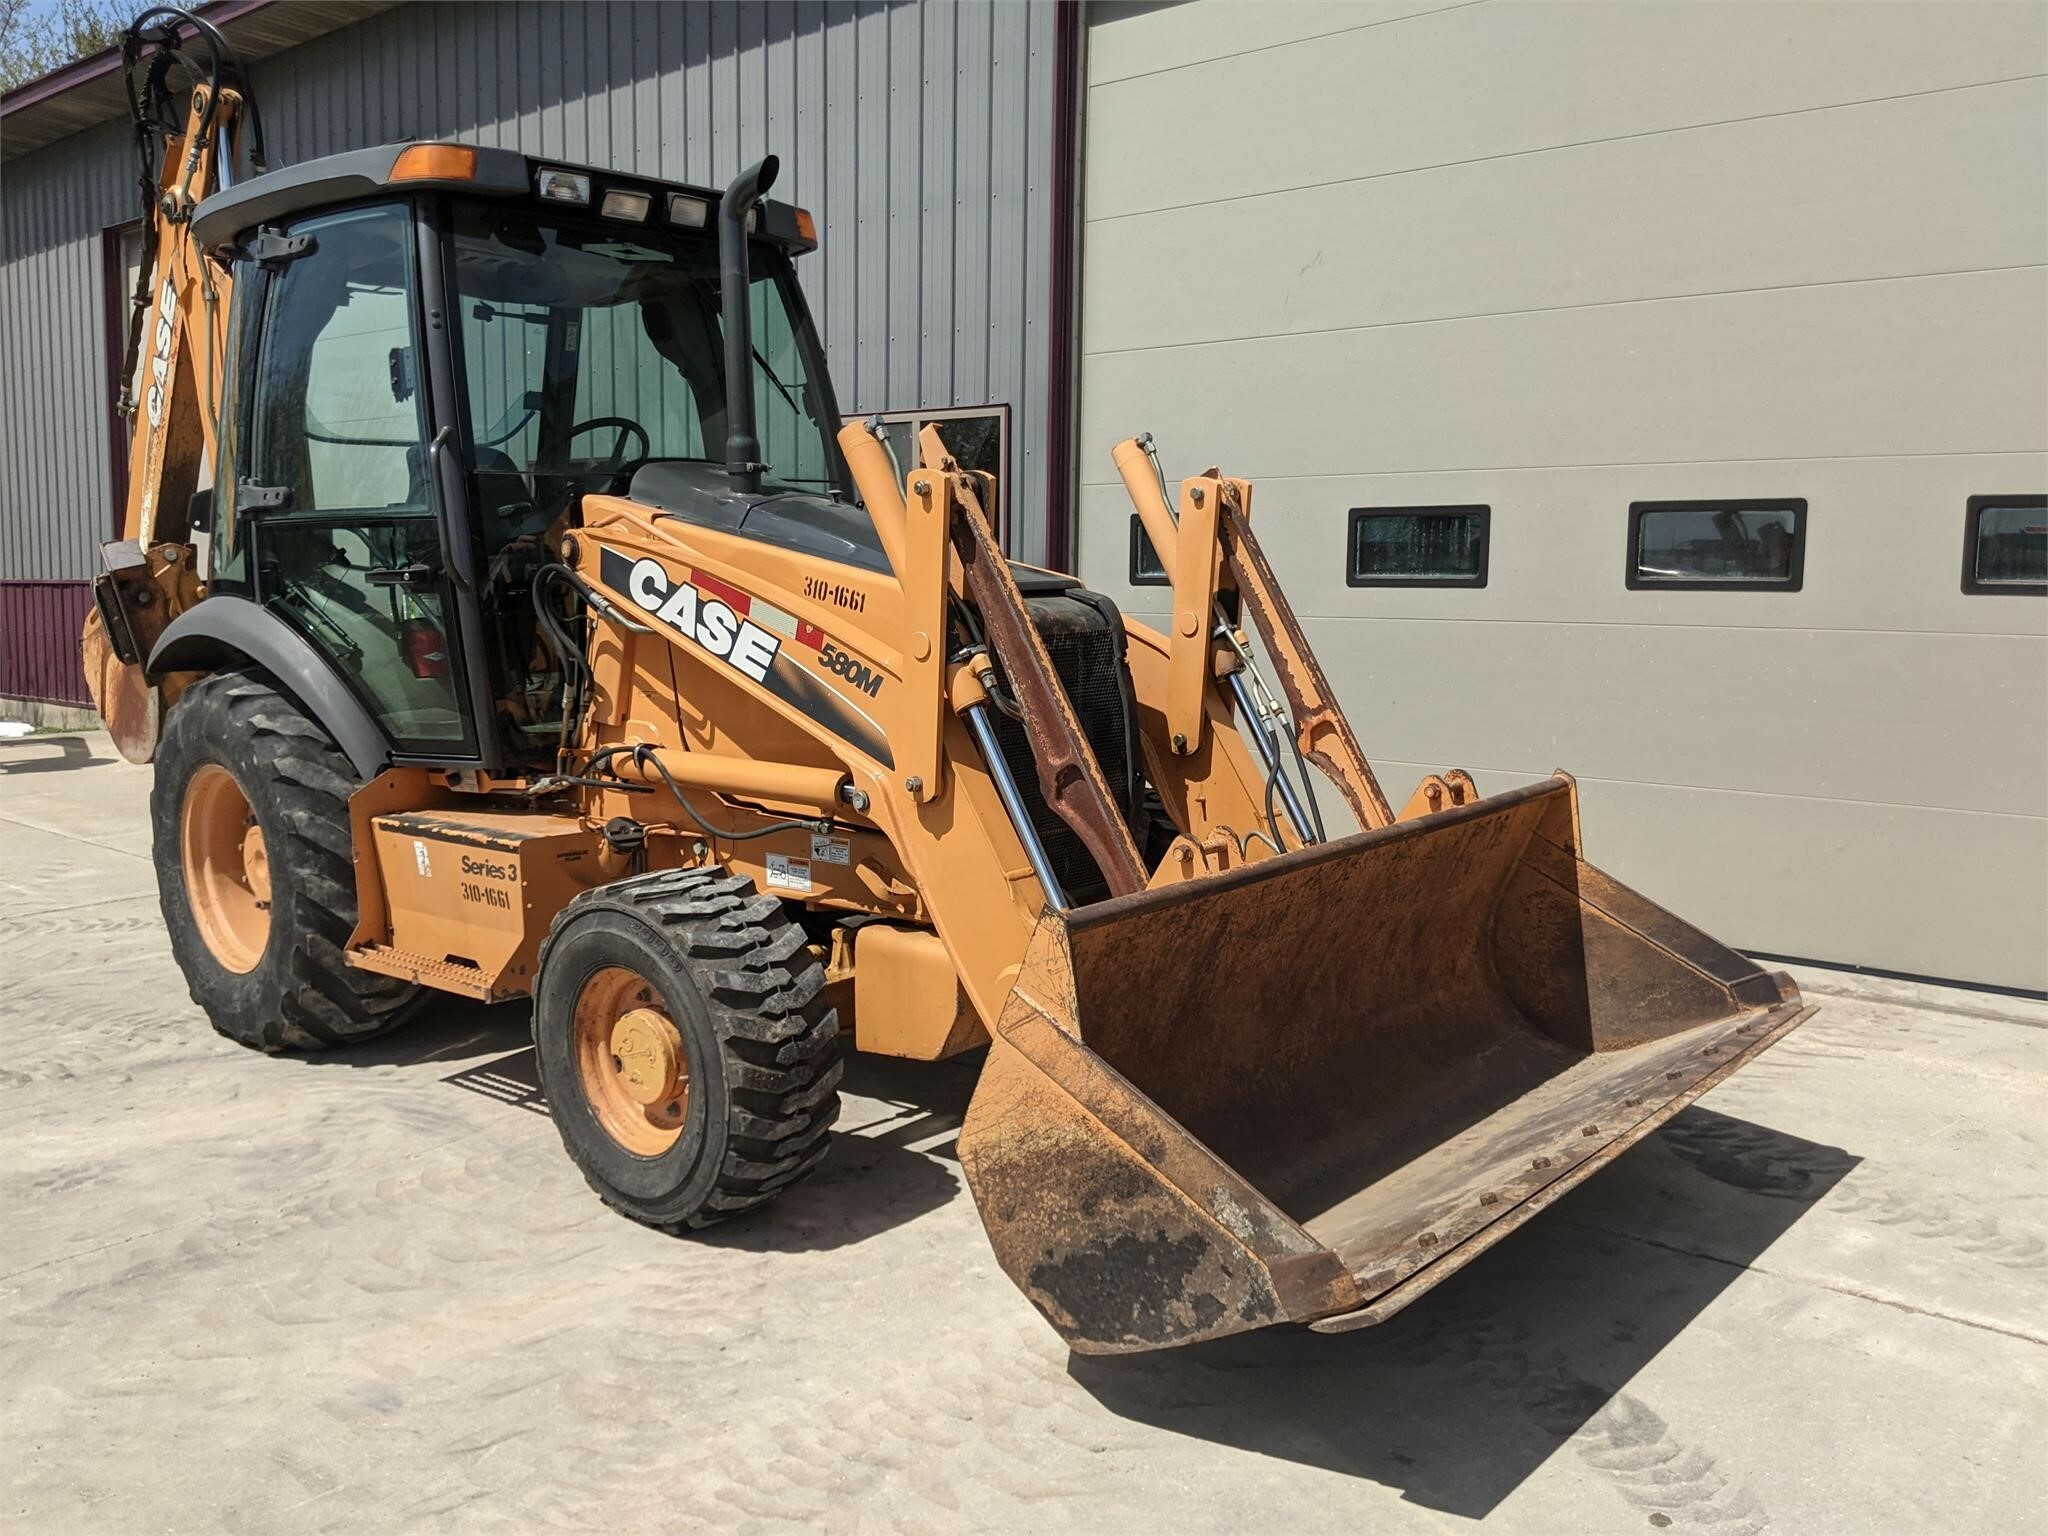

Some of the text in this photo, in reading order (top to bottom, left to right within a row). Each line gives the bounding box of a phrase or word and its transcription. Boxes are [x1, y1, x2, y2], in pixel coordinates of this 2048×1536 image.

[147, 276, 177, 428] CASE
[803, 576, 866, 613] 310-1661
[628, 559, 781, 683] CASE
[818, 642, 884, 698] 580M
[461, 855, 517, 882] Series 3
[461, 882, 511, 910] 310-1661
